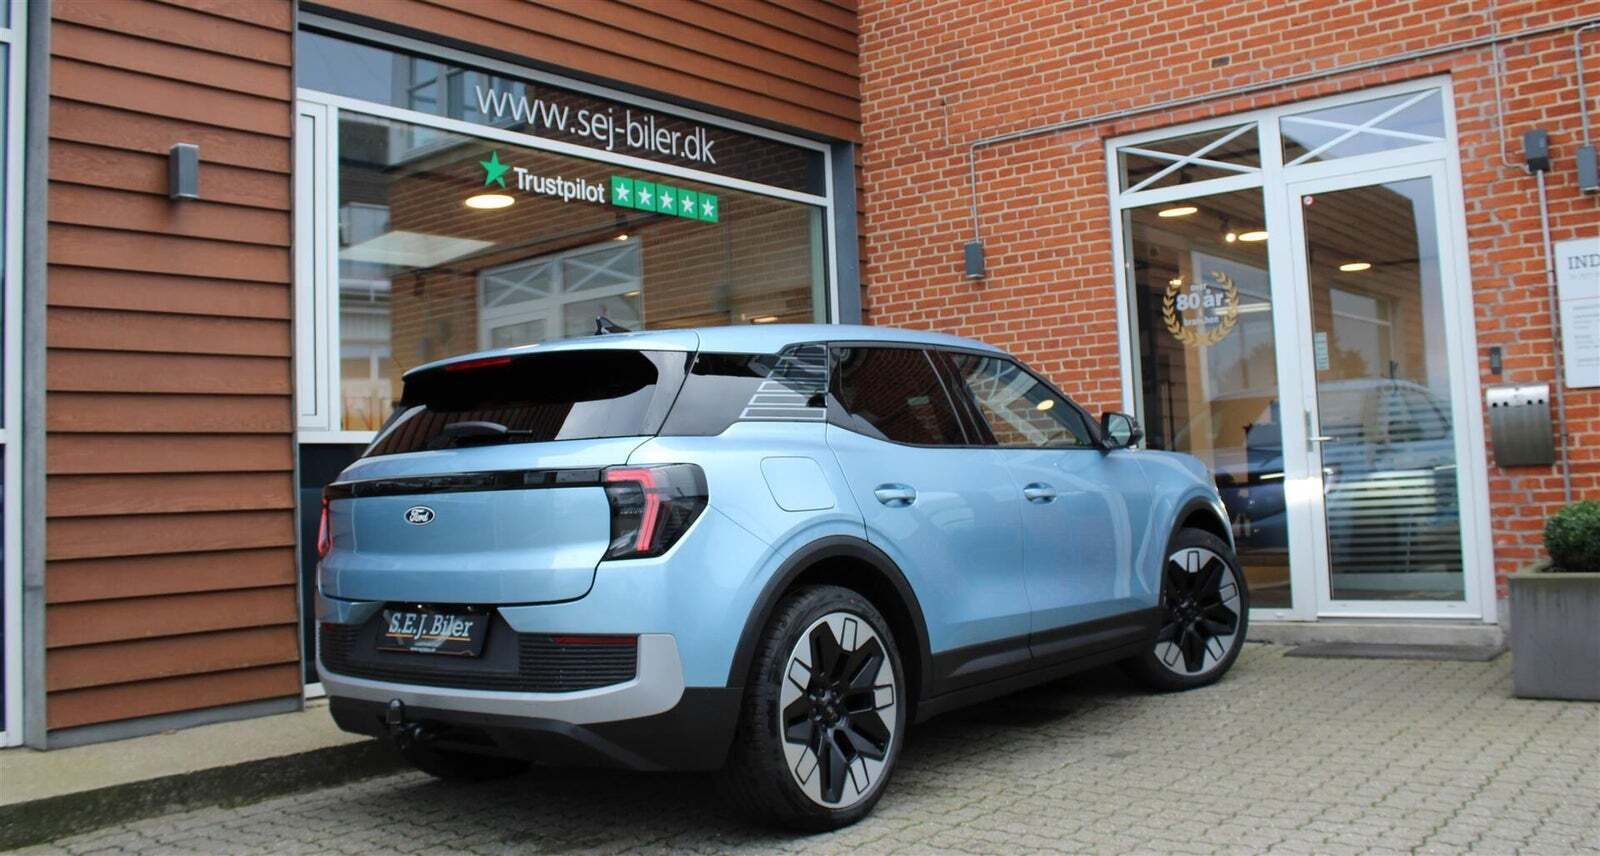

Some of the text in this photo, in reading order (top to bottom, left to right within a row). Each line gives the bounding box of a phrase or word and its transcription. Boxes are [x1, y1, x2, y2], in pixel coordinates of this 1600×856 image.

[476, 85, 716, 164] www.sej-biler.dk
[513, 167, 606, 203] Trustpilot
[1176, 288, 1224, 311] 80 år
[409, 508, 429, 522] Ford
[388, 613, 473, 640] S.E.J. Biler
